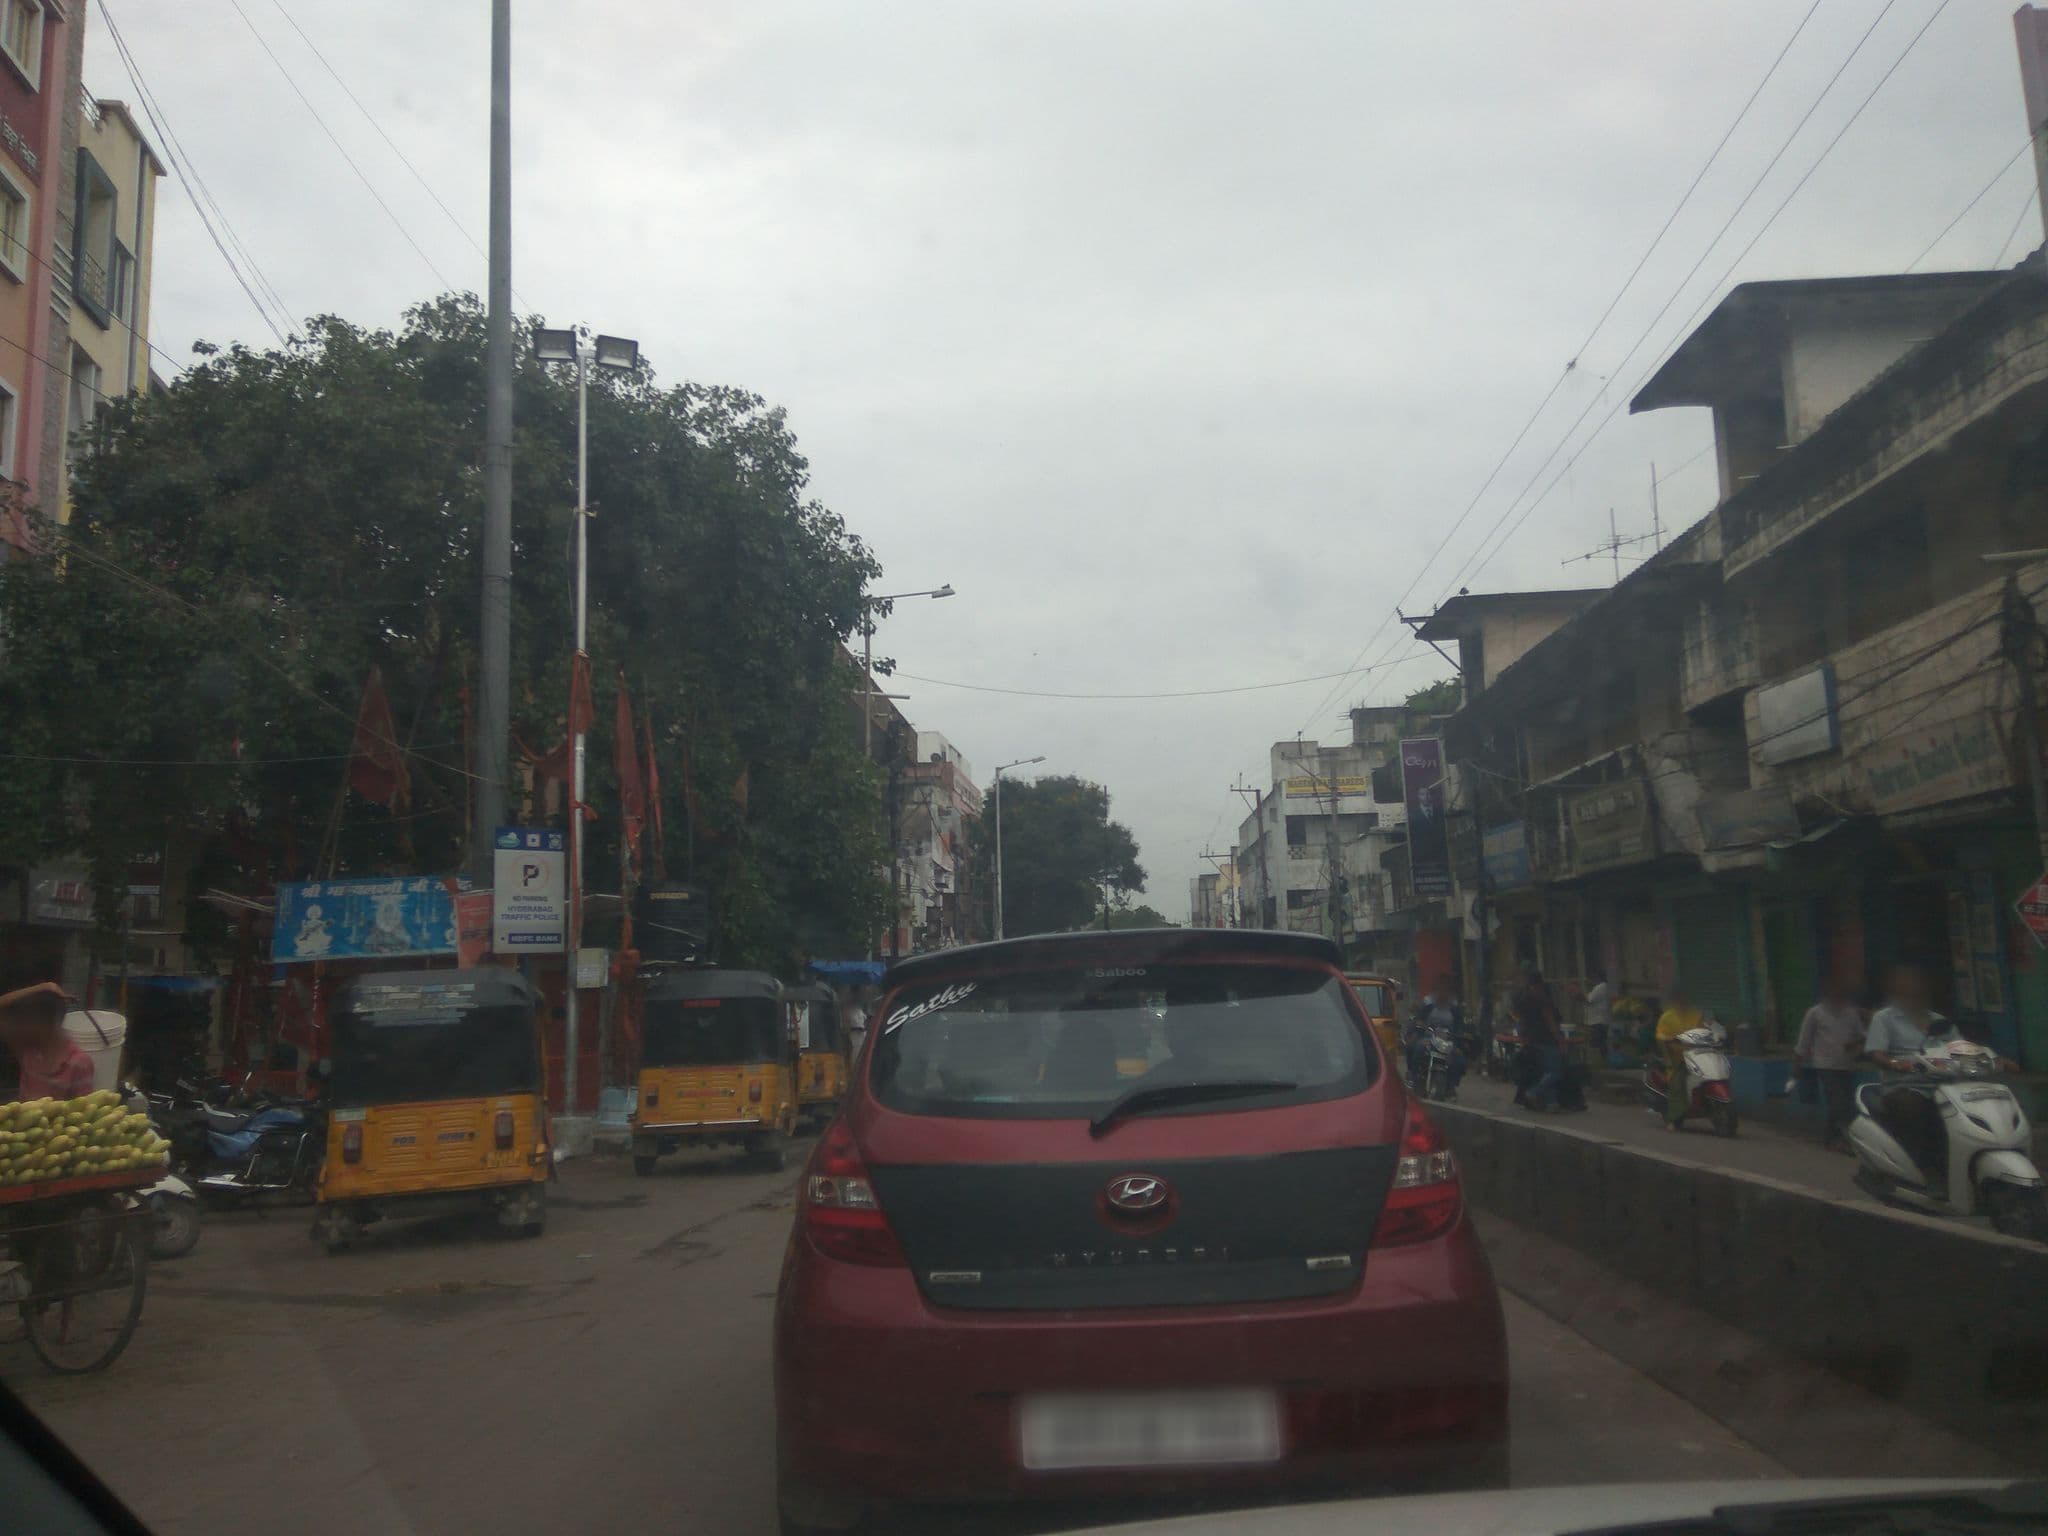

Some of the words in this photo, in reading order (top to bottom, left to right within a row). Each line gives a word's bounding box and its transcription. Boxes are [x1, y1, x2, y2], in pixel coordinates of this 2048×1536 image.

[507, 905, 553, 913] HYDERABAD
[501, 913, 532, 921] TRAFFIC
[533, 913, 560, 921] POLICE
[536, 934, 559, 942] BANK
